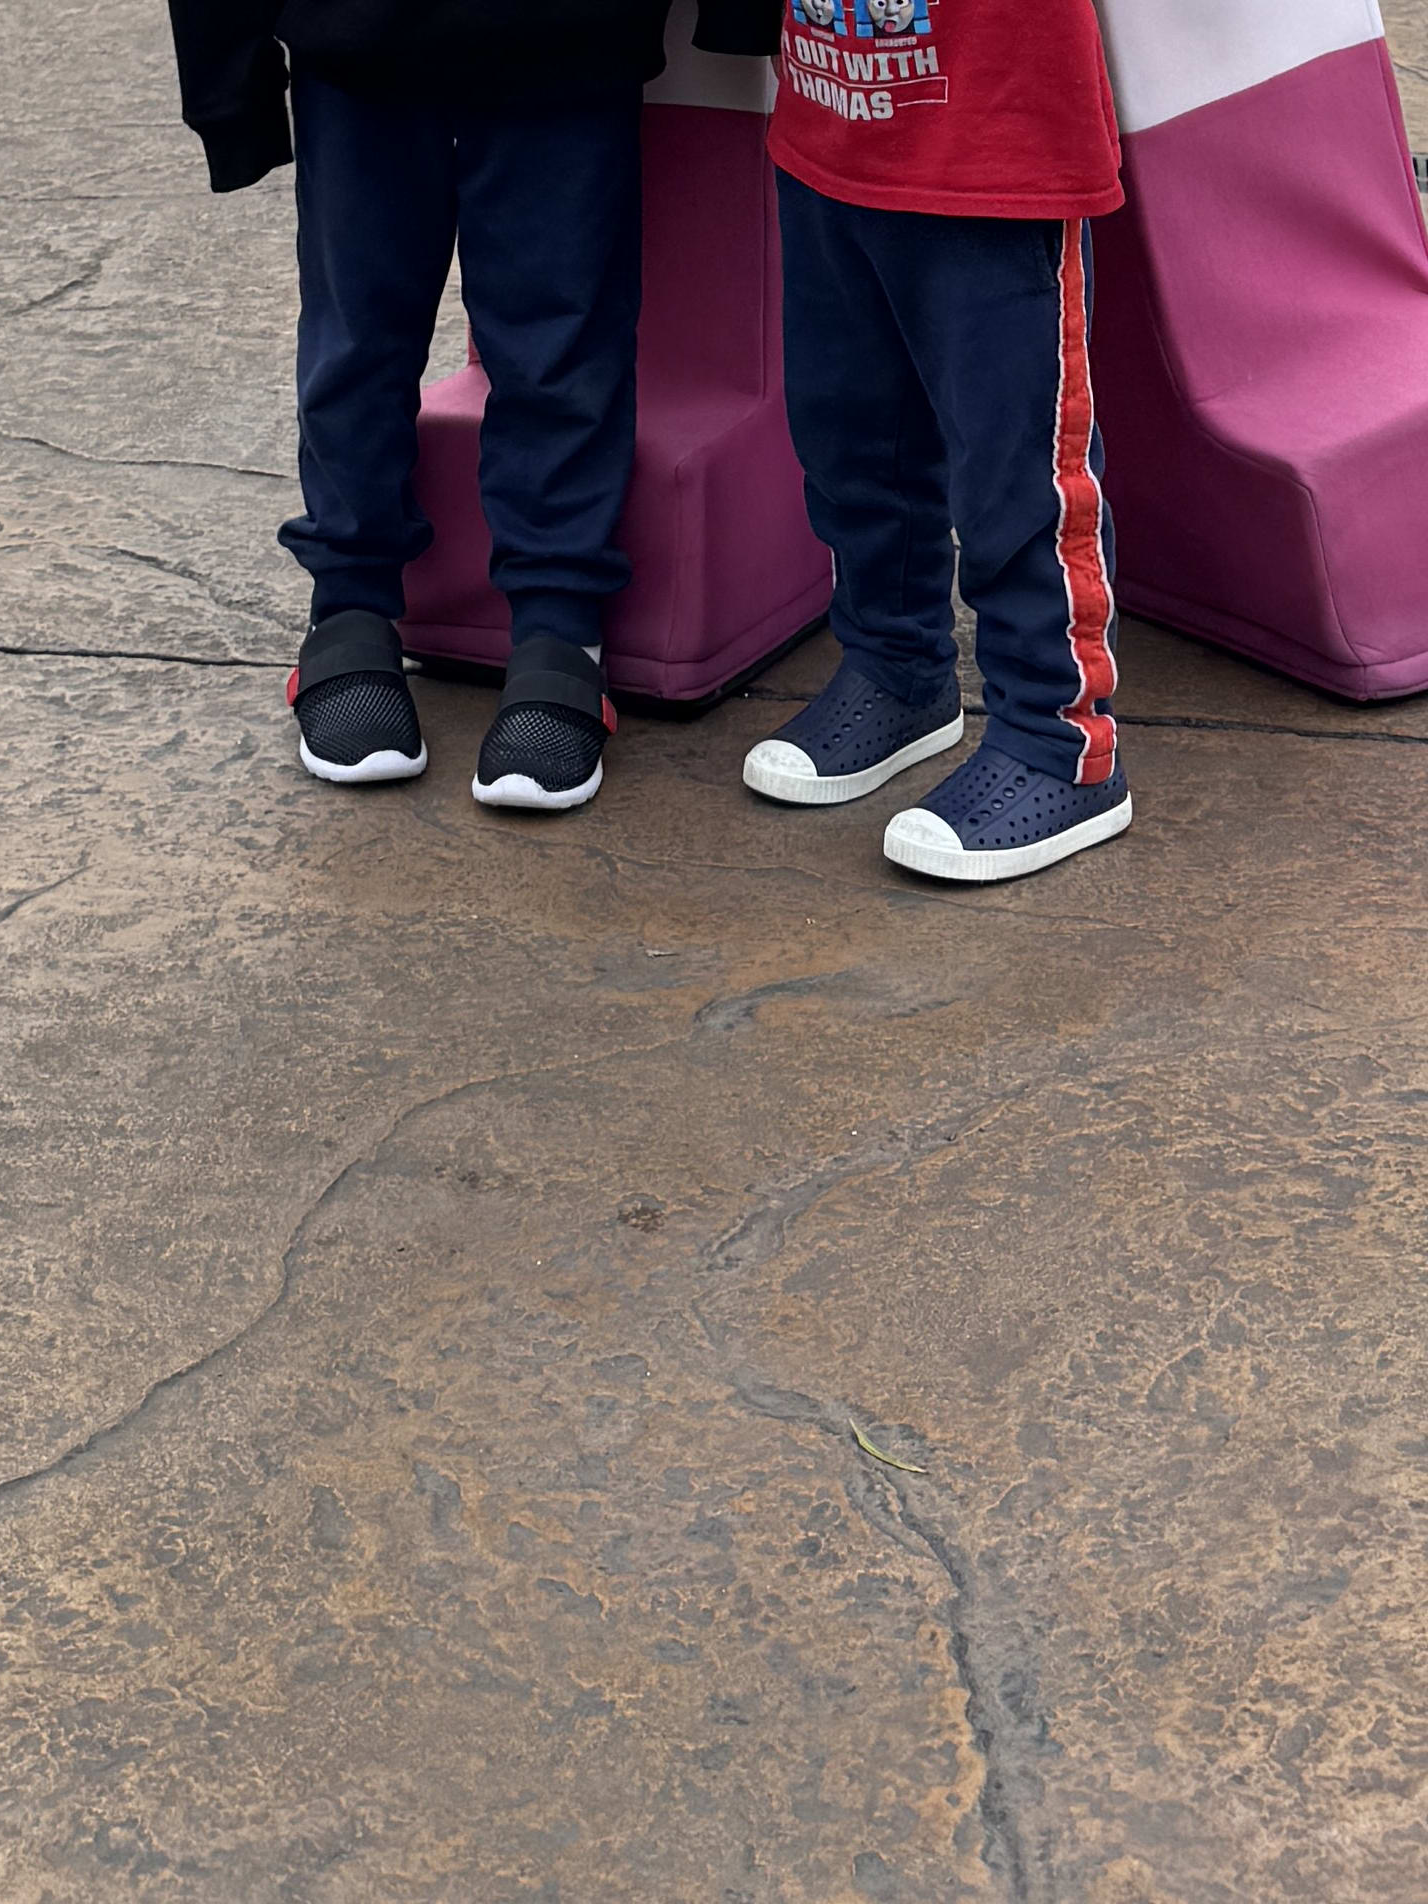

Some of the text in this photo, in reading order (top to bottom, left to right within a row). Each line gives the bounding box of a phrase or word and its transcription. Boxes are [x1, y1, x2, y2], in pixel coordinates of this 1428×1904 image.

[795, 35, 840, 74] OUT
[842, 45, 940, 82] WITH
[788, 62, 894, 121] THOMAS
